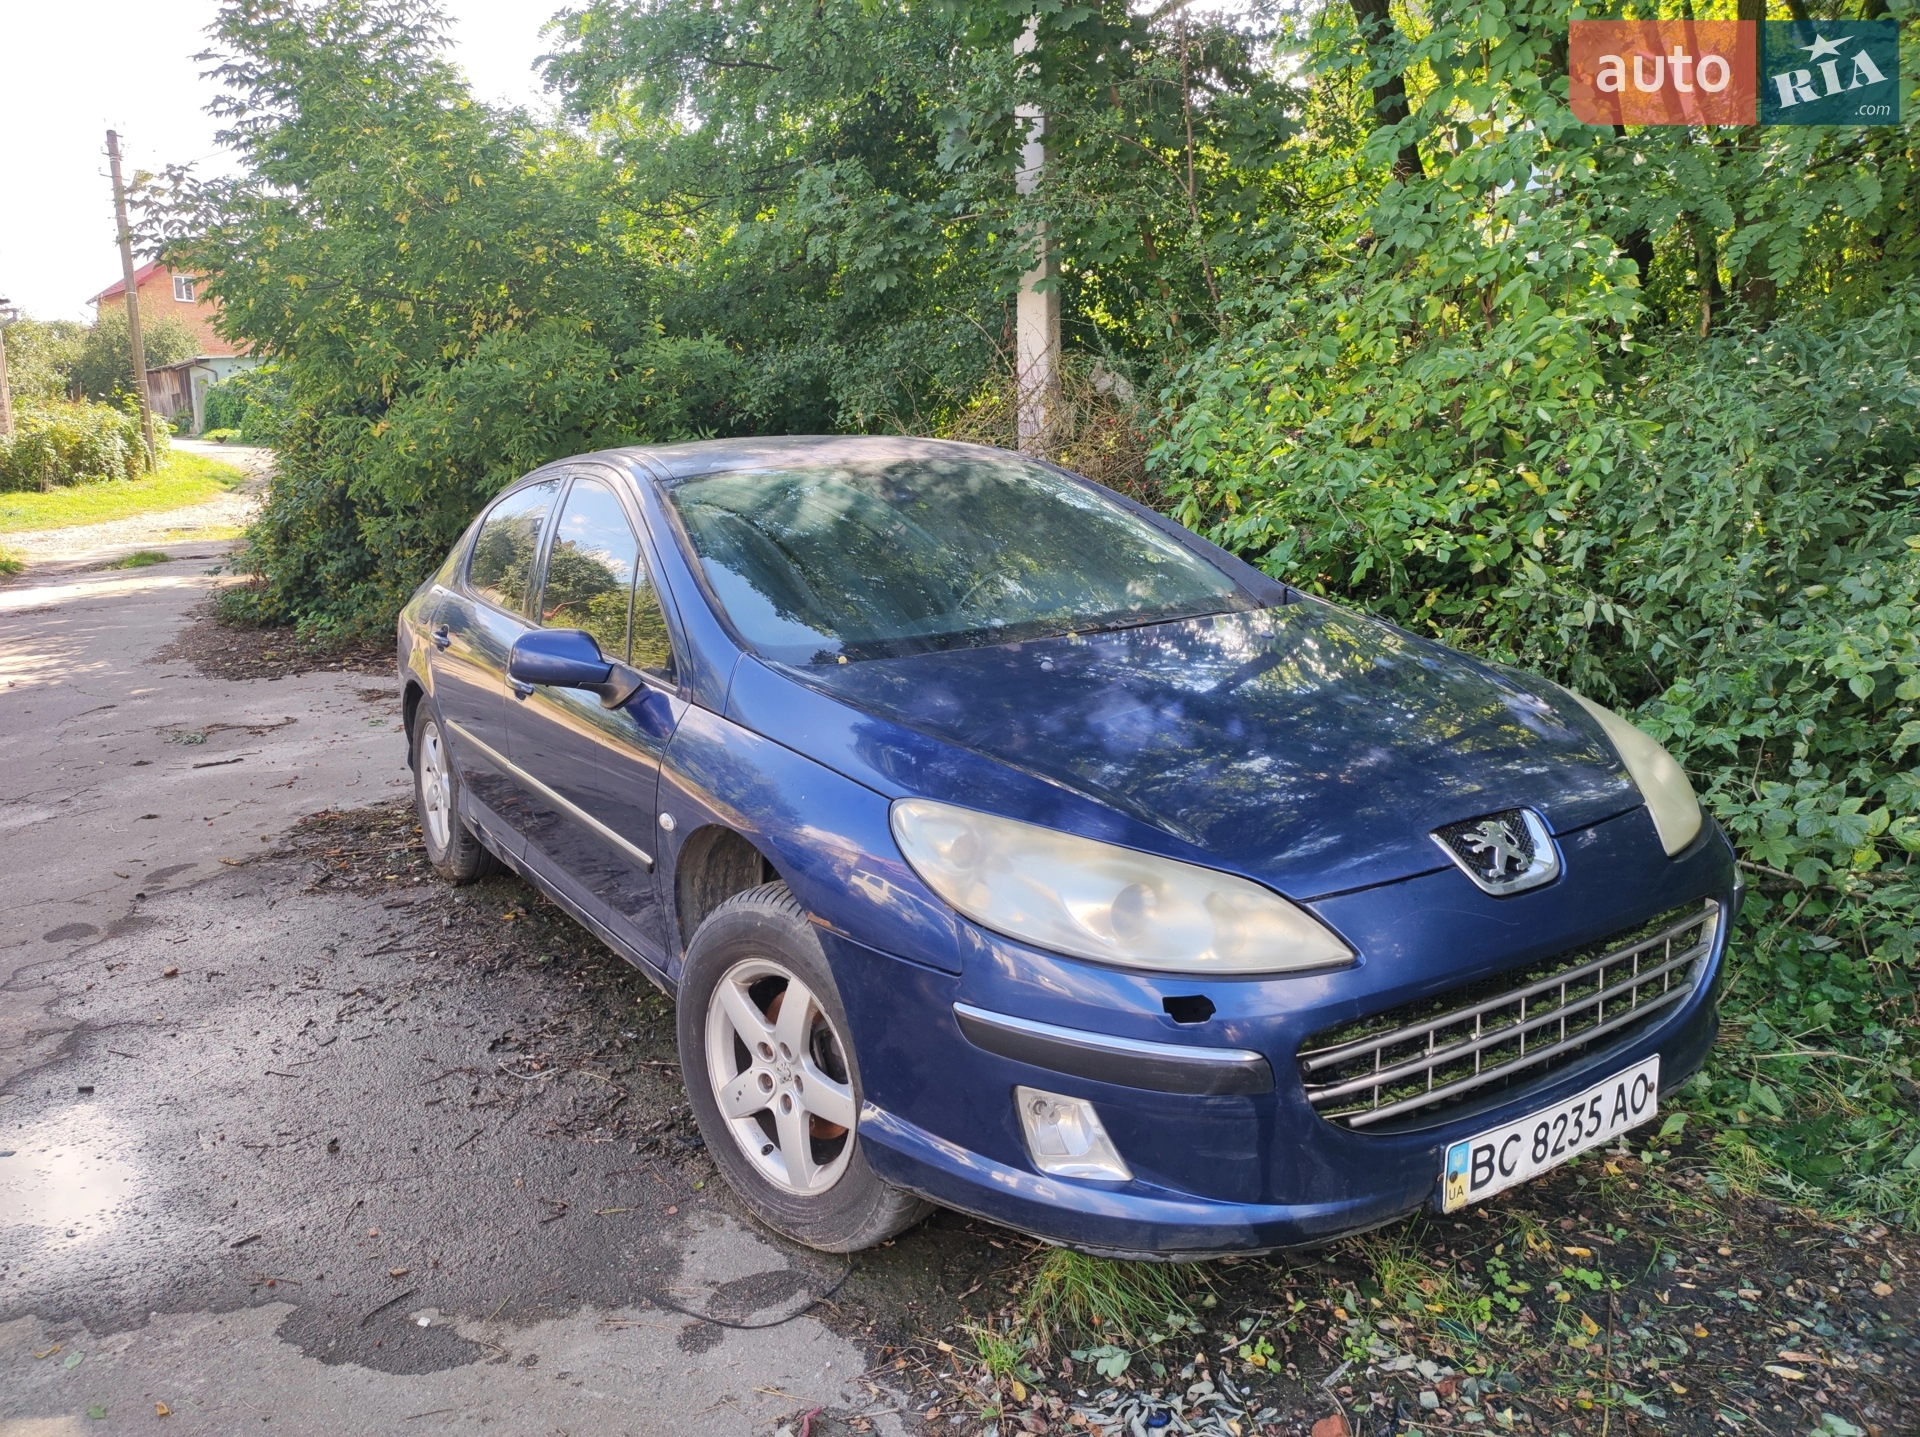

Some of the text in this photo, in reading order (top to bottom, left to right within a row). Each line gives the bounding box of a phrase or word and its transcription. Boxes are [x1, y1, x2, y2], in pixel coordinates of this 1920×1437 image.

[1469, 1072, 1648, 1192] BC 8235 AO
[1449, 1185, 1465, 1201] UA
